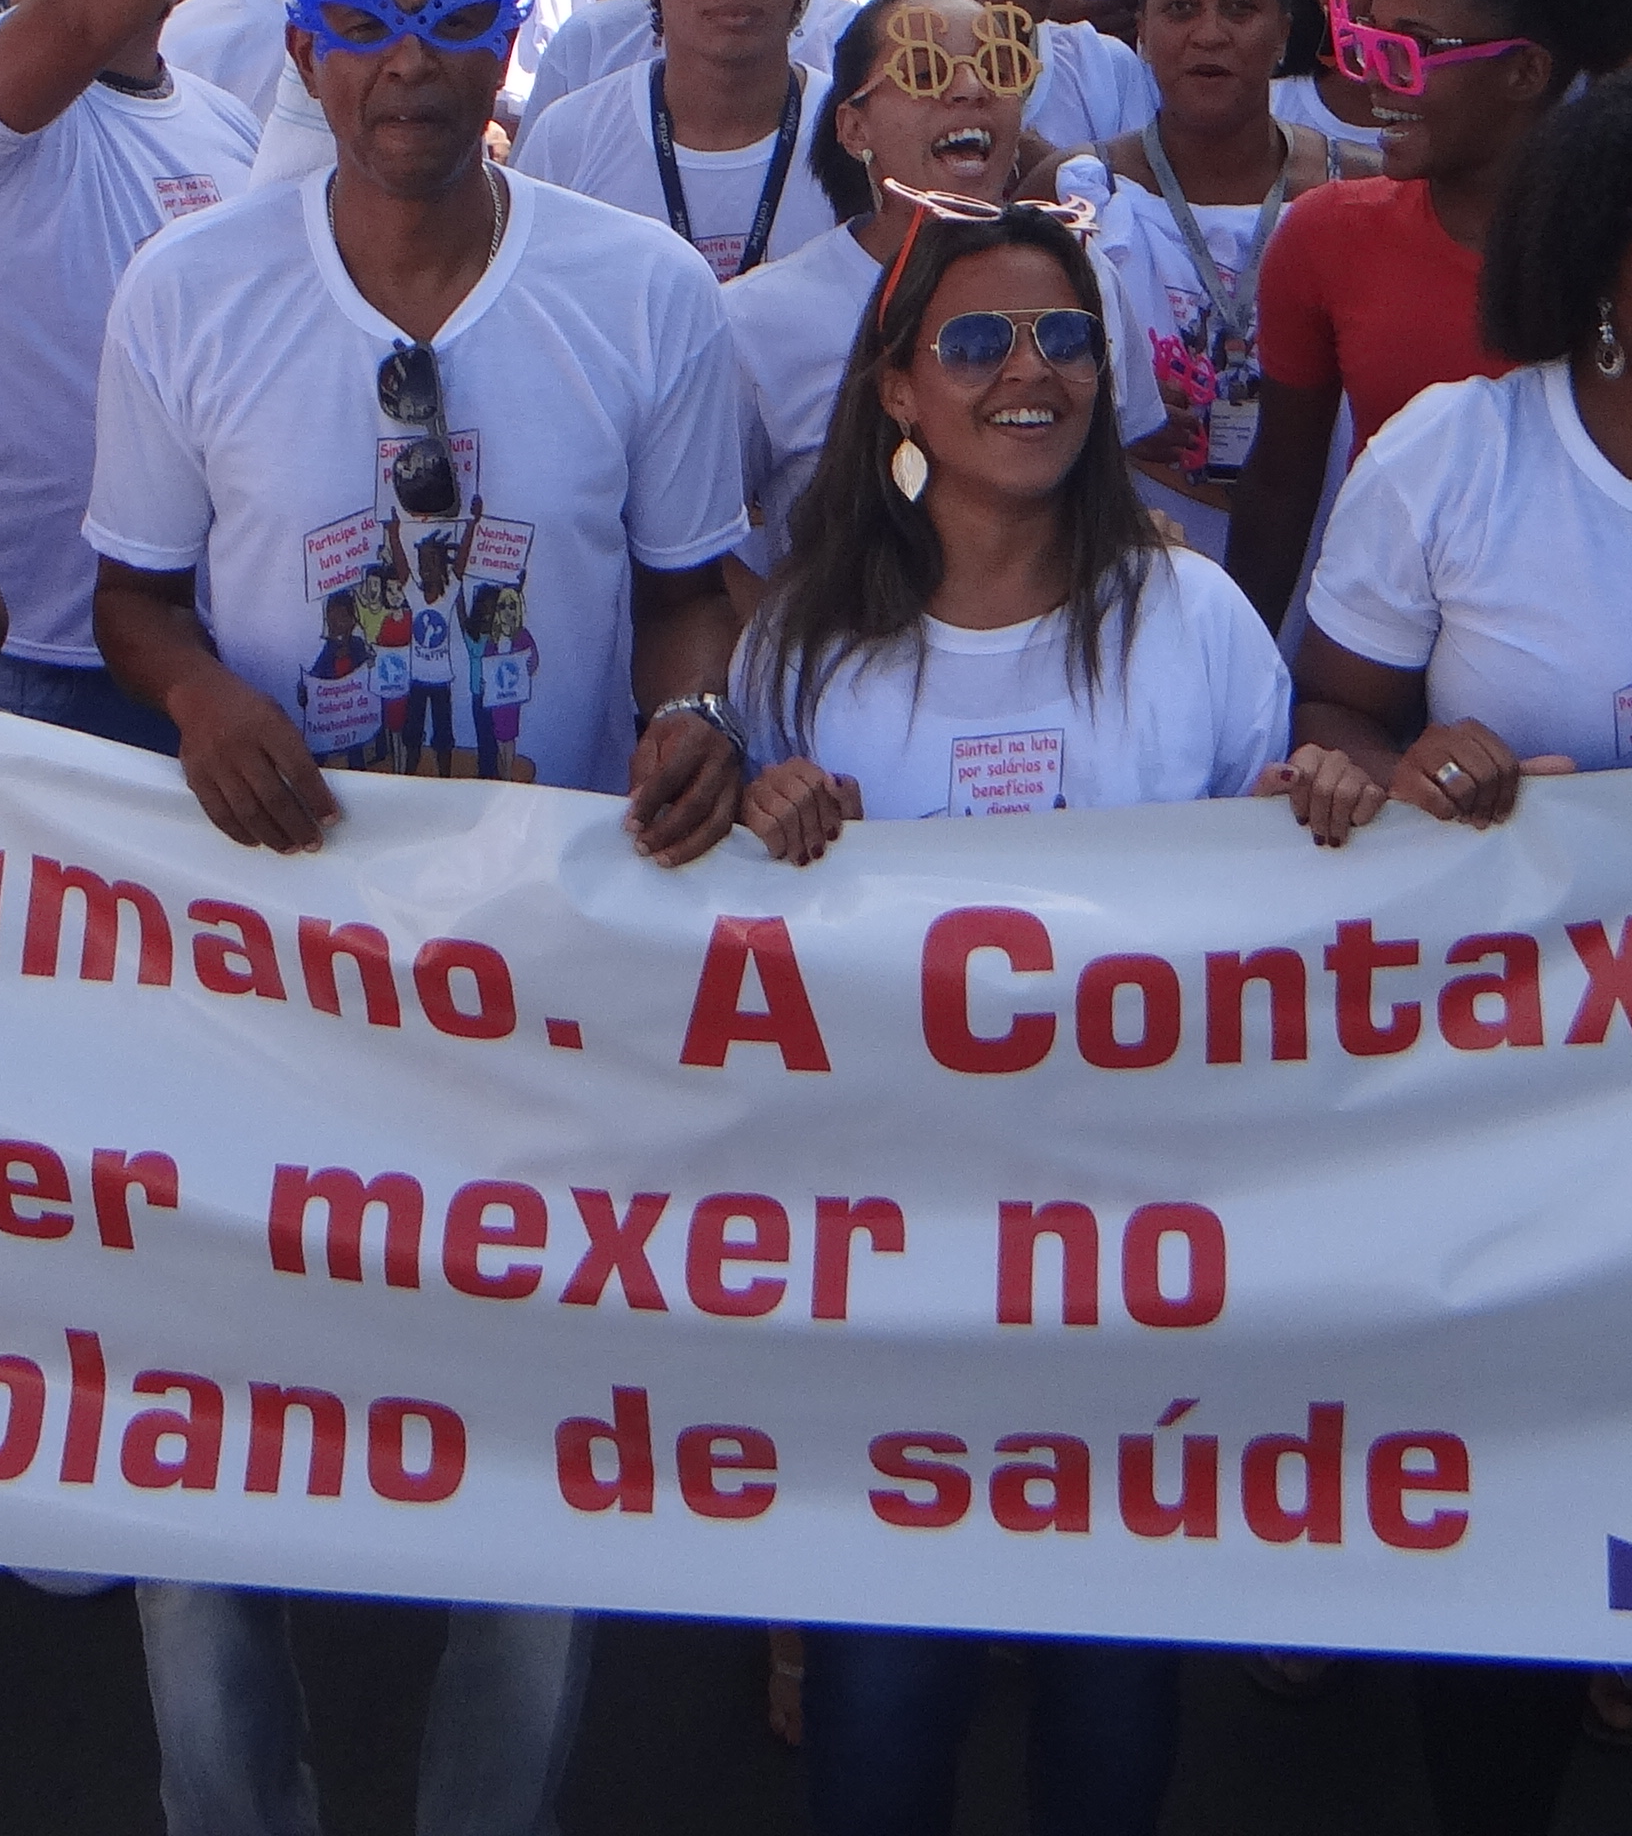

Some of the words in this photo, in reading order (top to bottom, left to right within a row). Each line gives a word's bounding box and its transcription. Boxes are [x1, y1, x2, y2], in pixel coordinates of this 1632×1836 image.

[307, 523, 358, 554] Participe
[476, 524, 528, 548] Nenhum
[476, 539, 522, 559] direito
[481, 557, 522, 572] menos
[954, 741, 1003, 759] Sinttel
[1007, 740, 1026, 754] na
[1030, 735, 1058, 752] luta
[957, 764, 982, 783] por
[986, 755, 1042, 776] salários
[1046, 758, 1056, 771] e
[971, 778, 1045, 800] benefícios
[678, 913, 832, 1073] A
[268, 1162, 907, 1321] mexer
[996, 1200, 1228, 1329] no
[553, 1385, 779, 1521] de
[866, 1395, 1472, 1552] saúde
